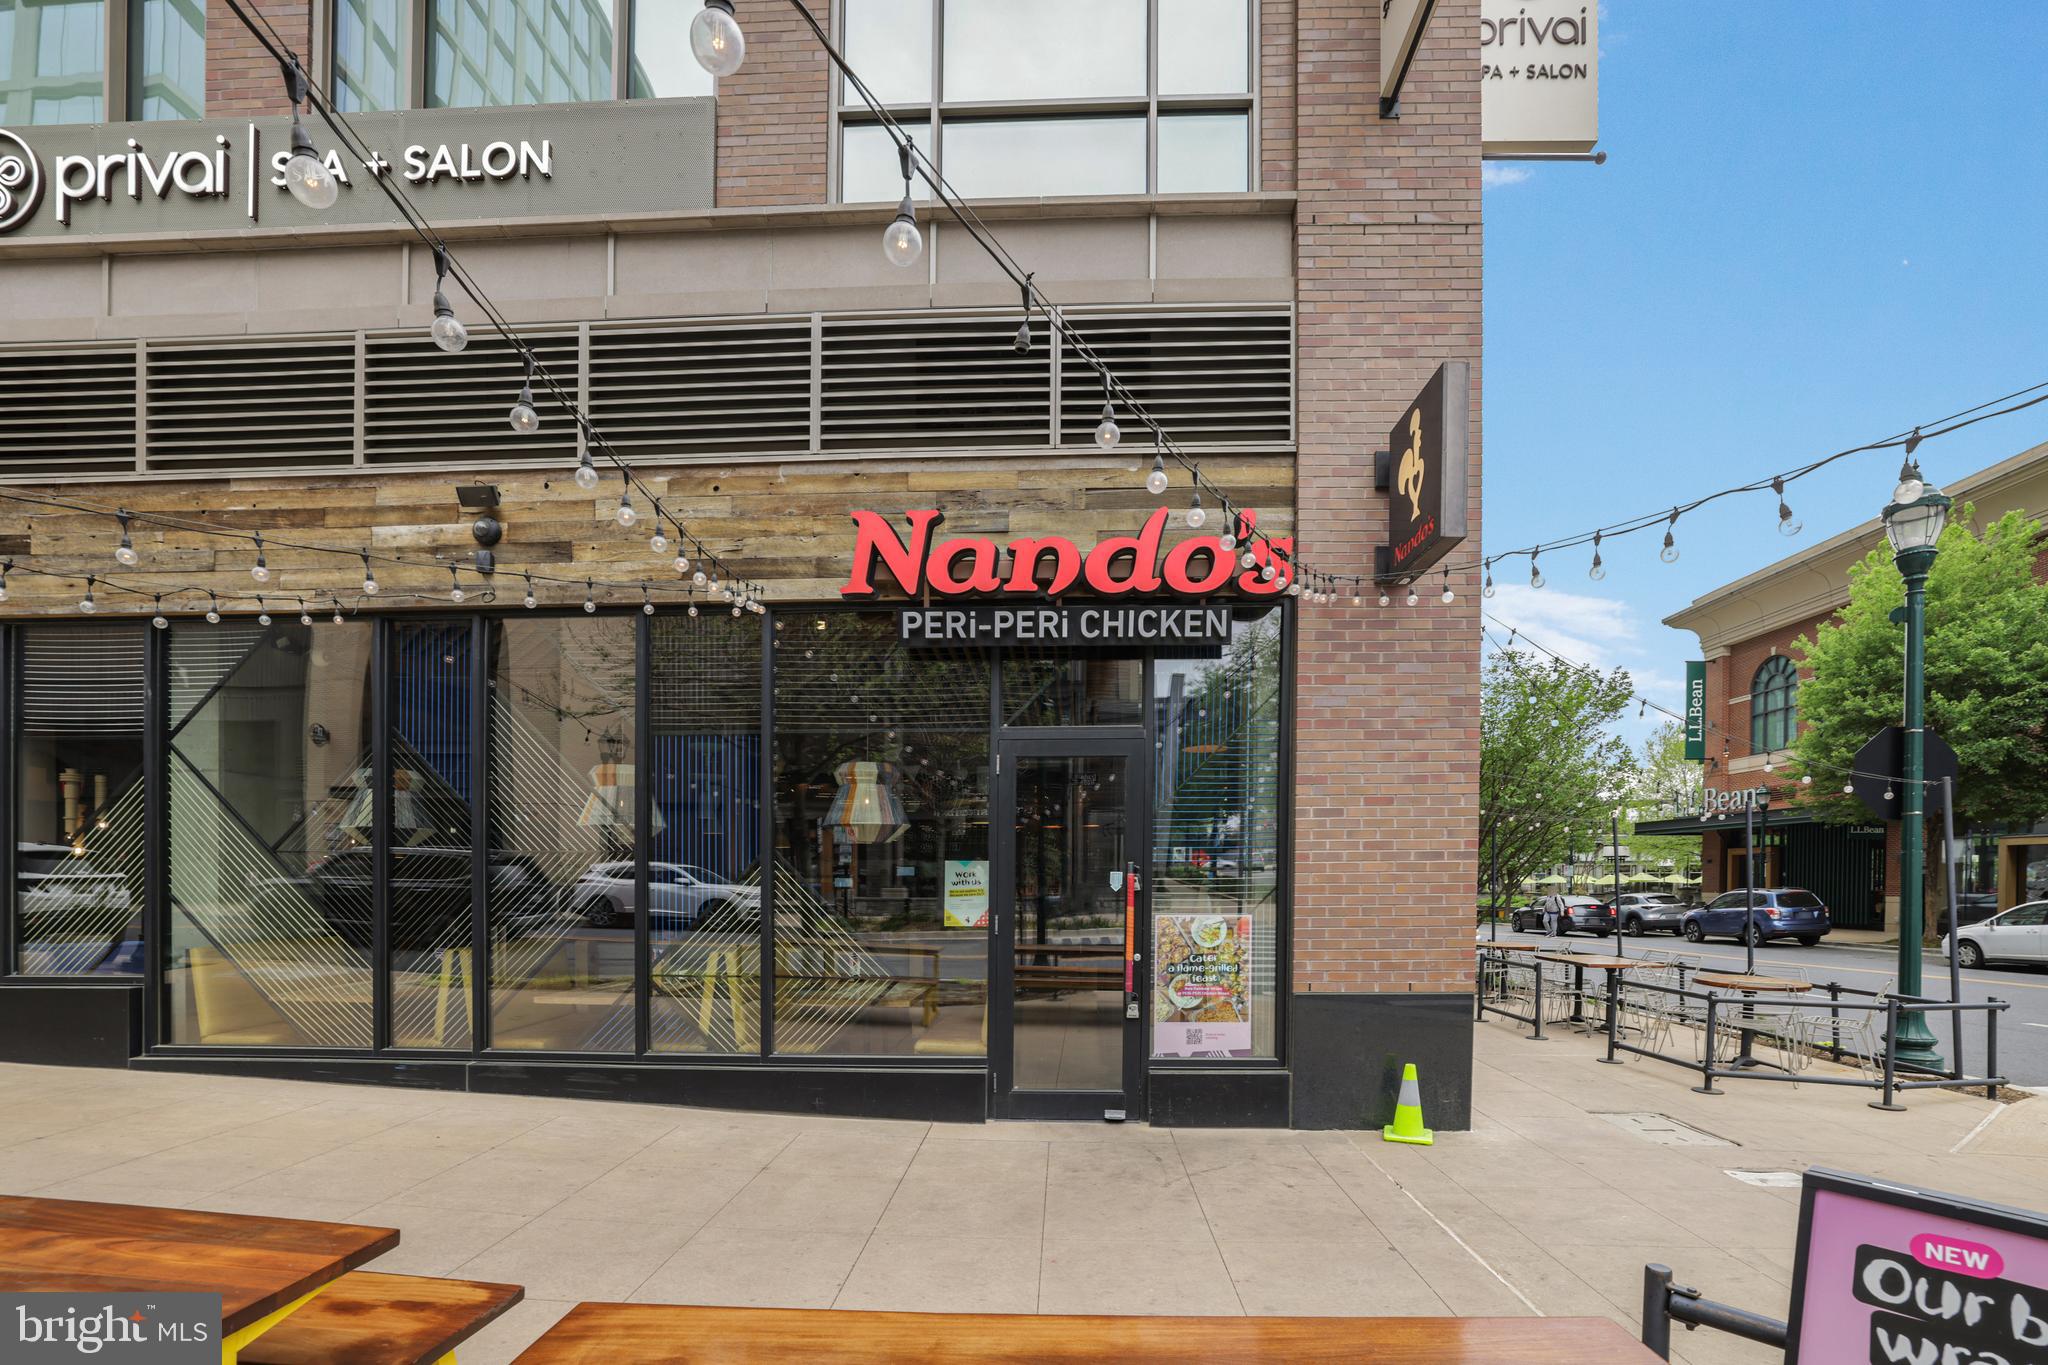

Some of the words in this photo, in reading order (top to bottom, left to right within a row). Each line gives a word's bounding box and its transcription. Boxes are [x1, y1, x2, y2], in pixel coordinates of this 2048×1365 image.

[1481, 64, 1504, 80] PA
[1526, 63, 1588, 80] SALON
[55, 133, 226, 222] privai
[403, 139, 551, 180] SALON
[839, 505, 1295, 596] Nando's
[1392, 513, 1435, 567] Nando's
[1080, 608, 1228, 640] CHICKEN
[1688, 679, 1704, 743] L.L.Bean
[1924, 1241, 1990, 1271] NEW
[1862, 1258, 1996, 1327] Our
